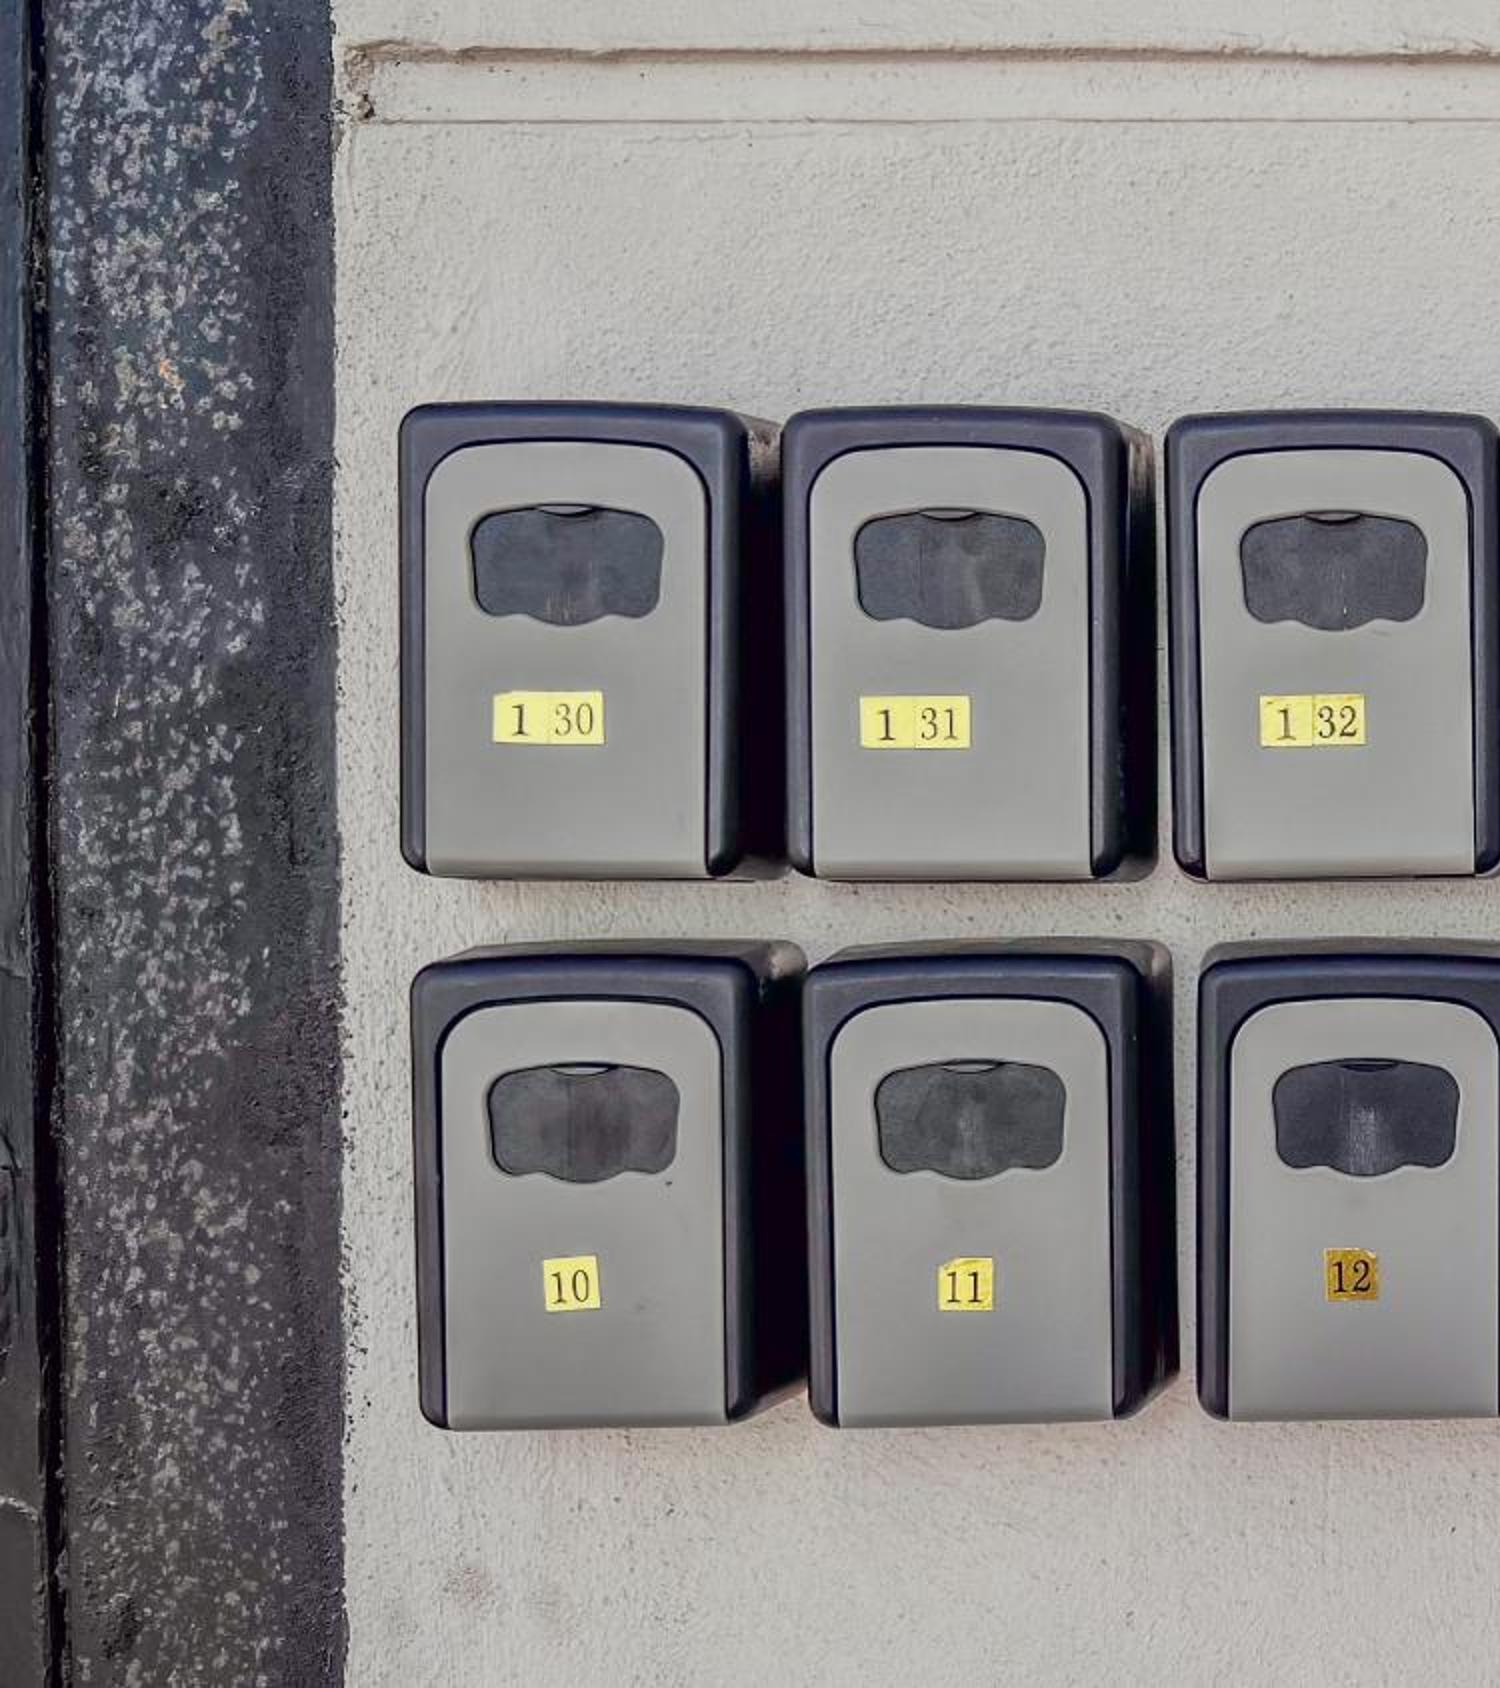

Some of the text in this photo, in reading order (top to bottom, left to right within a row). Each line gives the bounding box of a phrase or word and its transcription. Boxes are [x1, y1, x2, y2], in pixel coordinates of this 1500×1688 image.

[551, 1269, 589, 1304] 10
[947, 1271, 982, 1303] 11
[1333, 1260, 1371, 1293] 12
